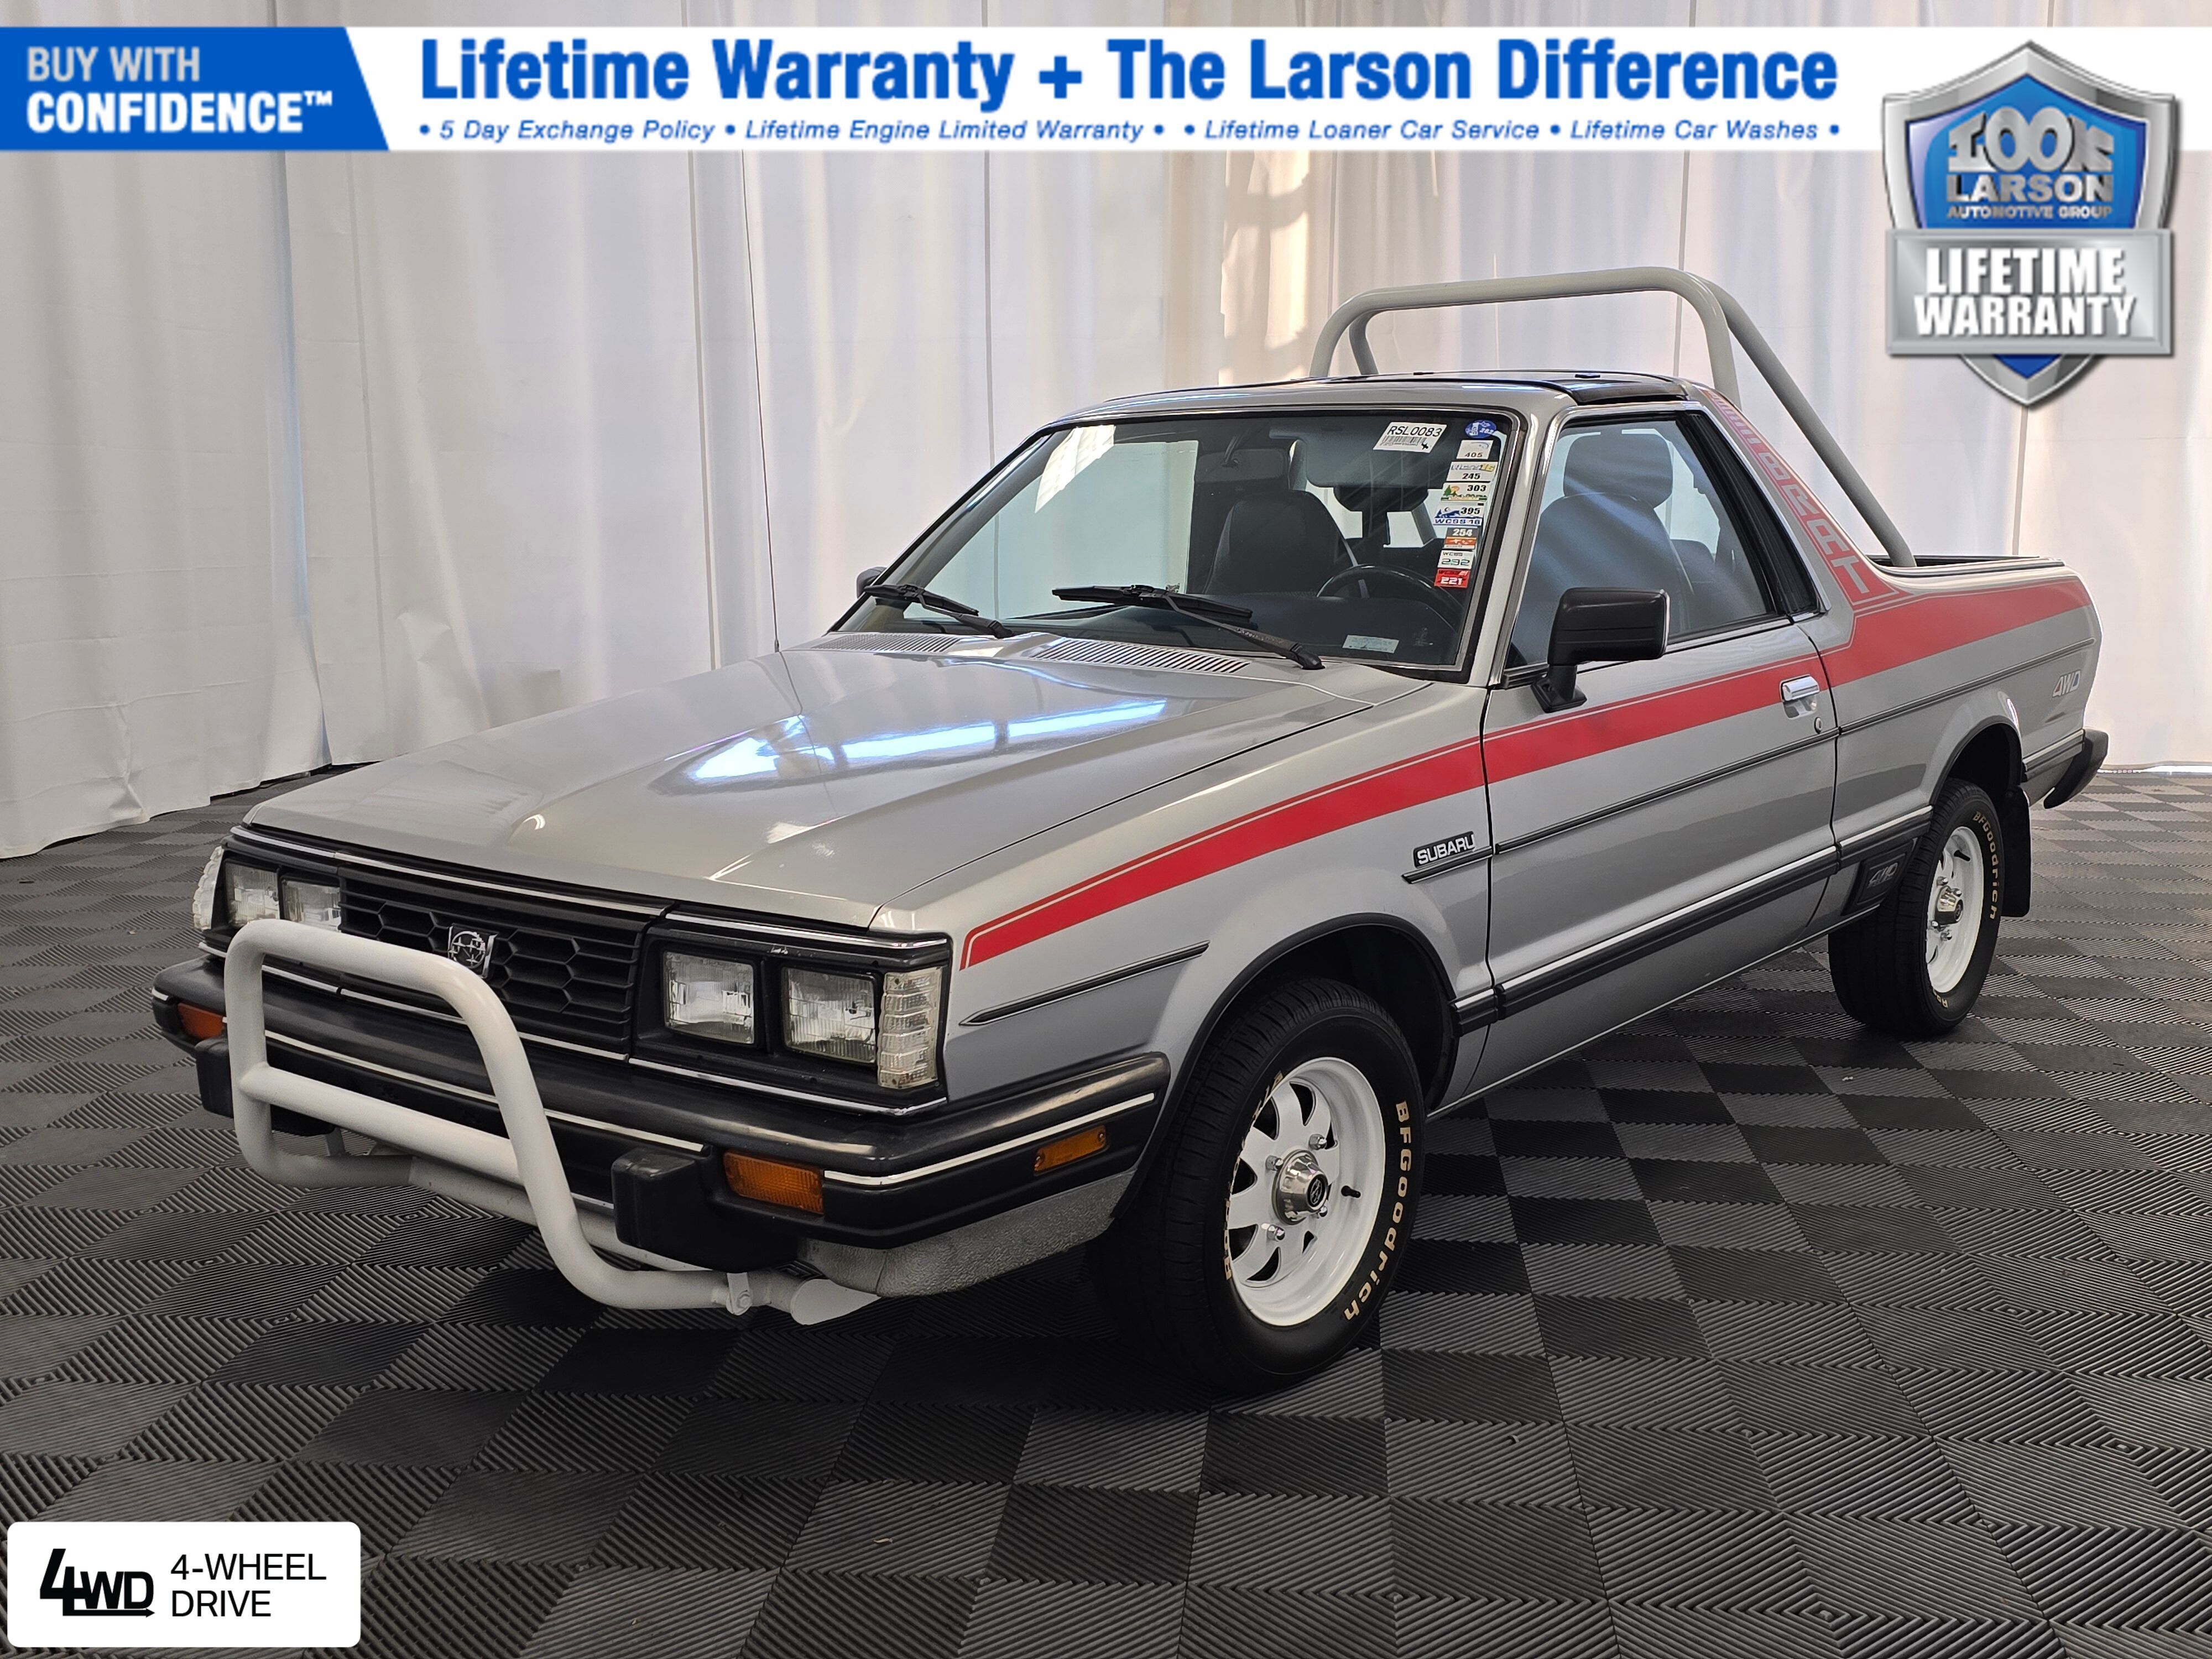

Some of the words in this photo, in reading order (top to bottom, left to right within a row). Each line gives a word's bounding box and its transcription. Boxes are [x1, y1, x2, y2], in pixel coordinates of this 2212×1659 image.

[1386, 425, 1443, 437] RSL0083
[1759, 451, 1870, 594] BRAT
[1452, 528, 1473, 536] 254
[1441, 558, 1470, 566] 292
[1440, 576, 1463, 586] 221
[1417, 833, 1476, 865] SUBARU
[1344, 1100, 1412, 1321] BFGoodrich
